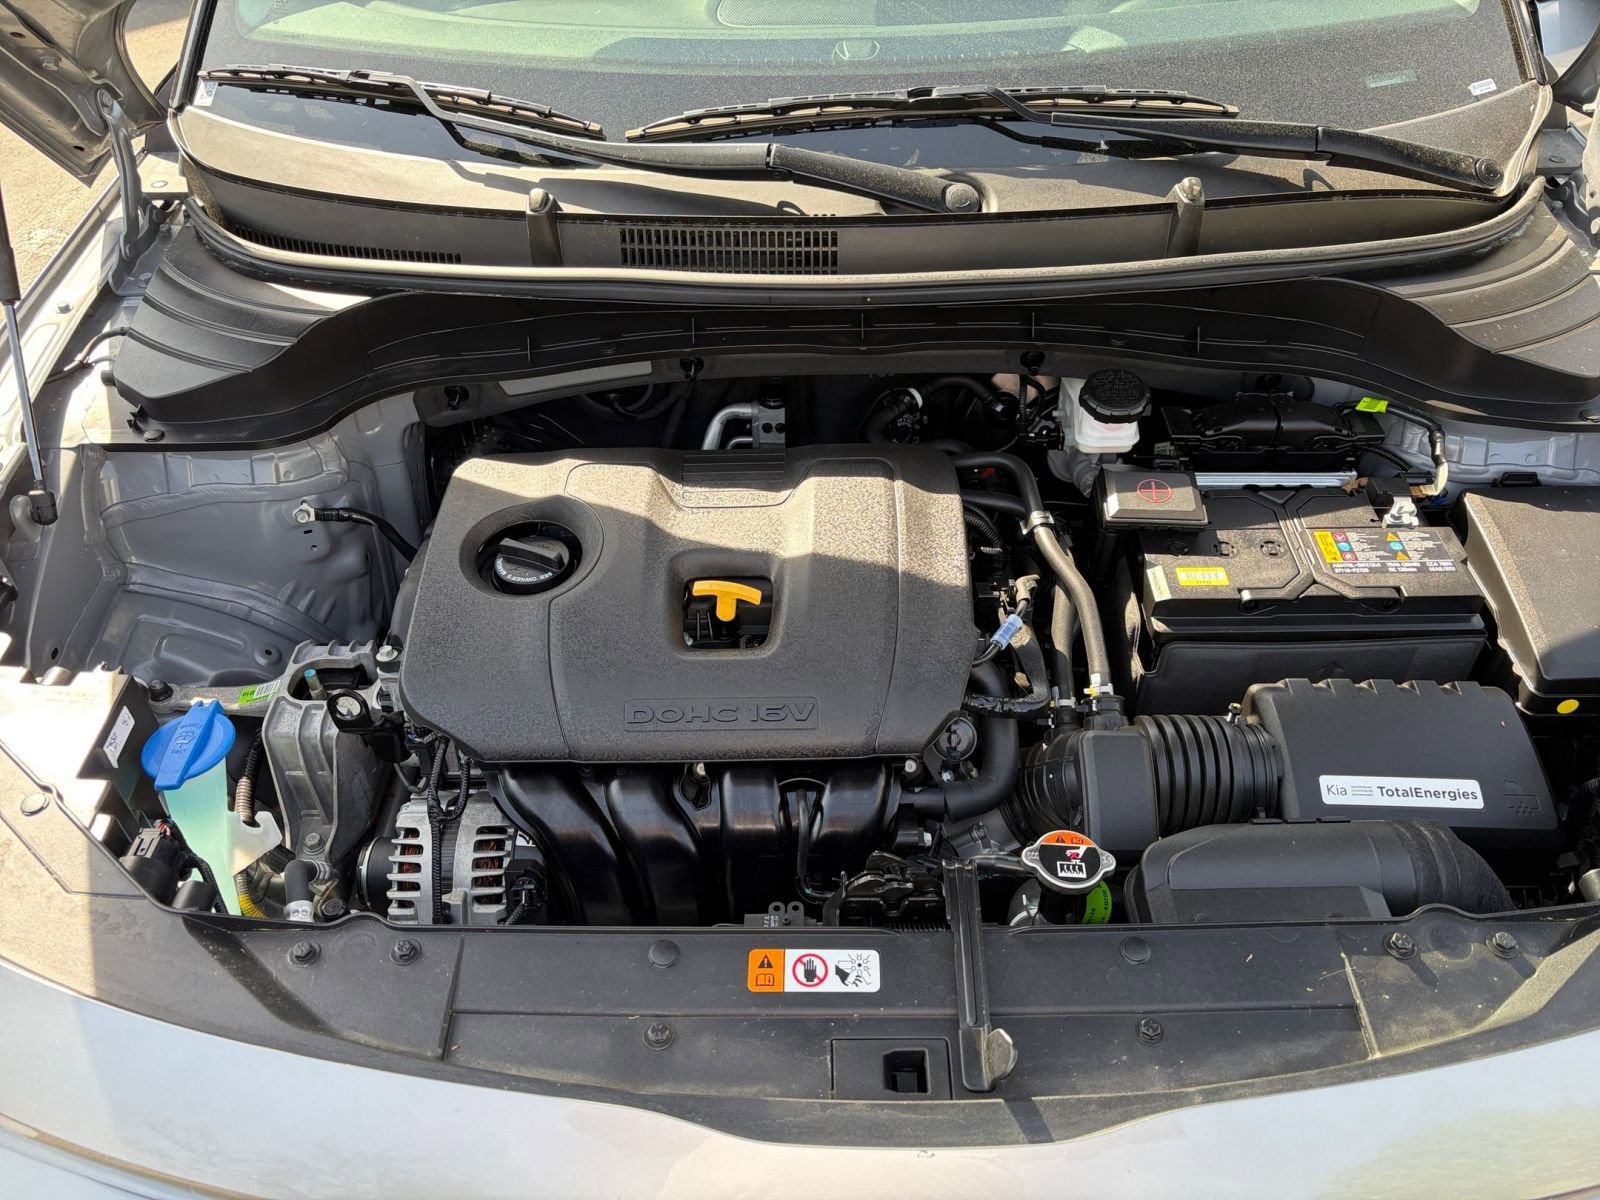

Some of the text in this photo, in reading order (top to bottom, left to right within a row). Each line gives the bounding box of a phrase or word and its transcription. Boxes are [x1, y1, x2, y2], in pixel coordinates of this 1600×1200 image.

[625, 703, 815, 724] DOHC 16V
[1326, 784, 1348, 796] Kia
[1376, 786, 1478, 801] TotalEnergies
